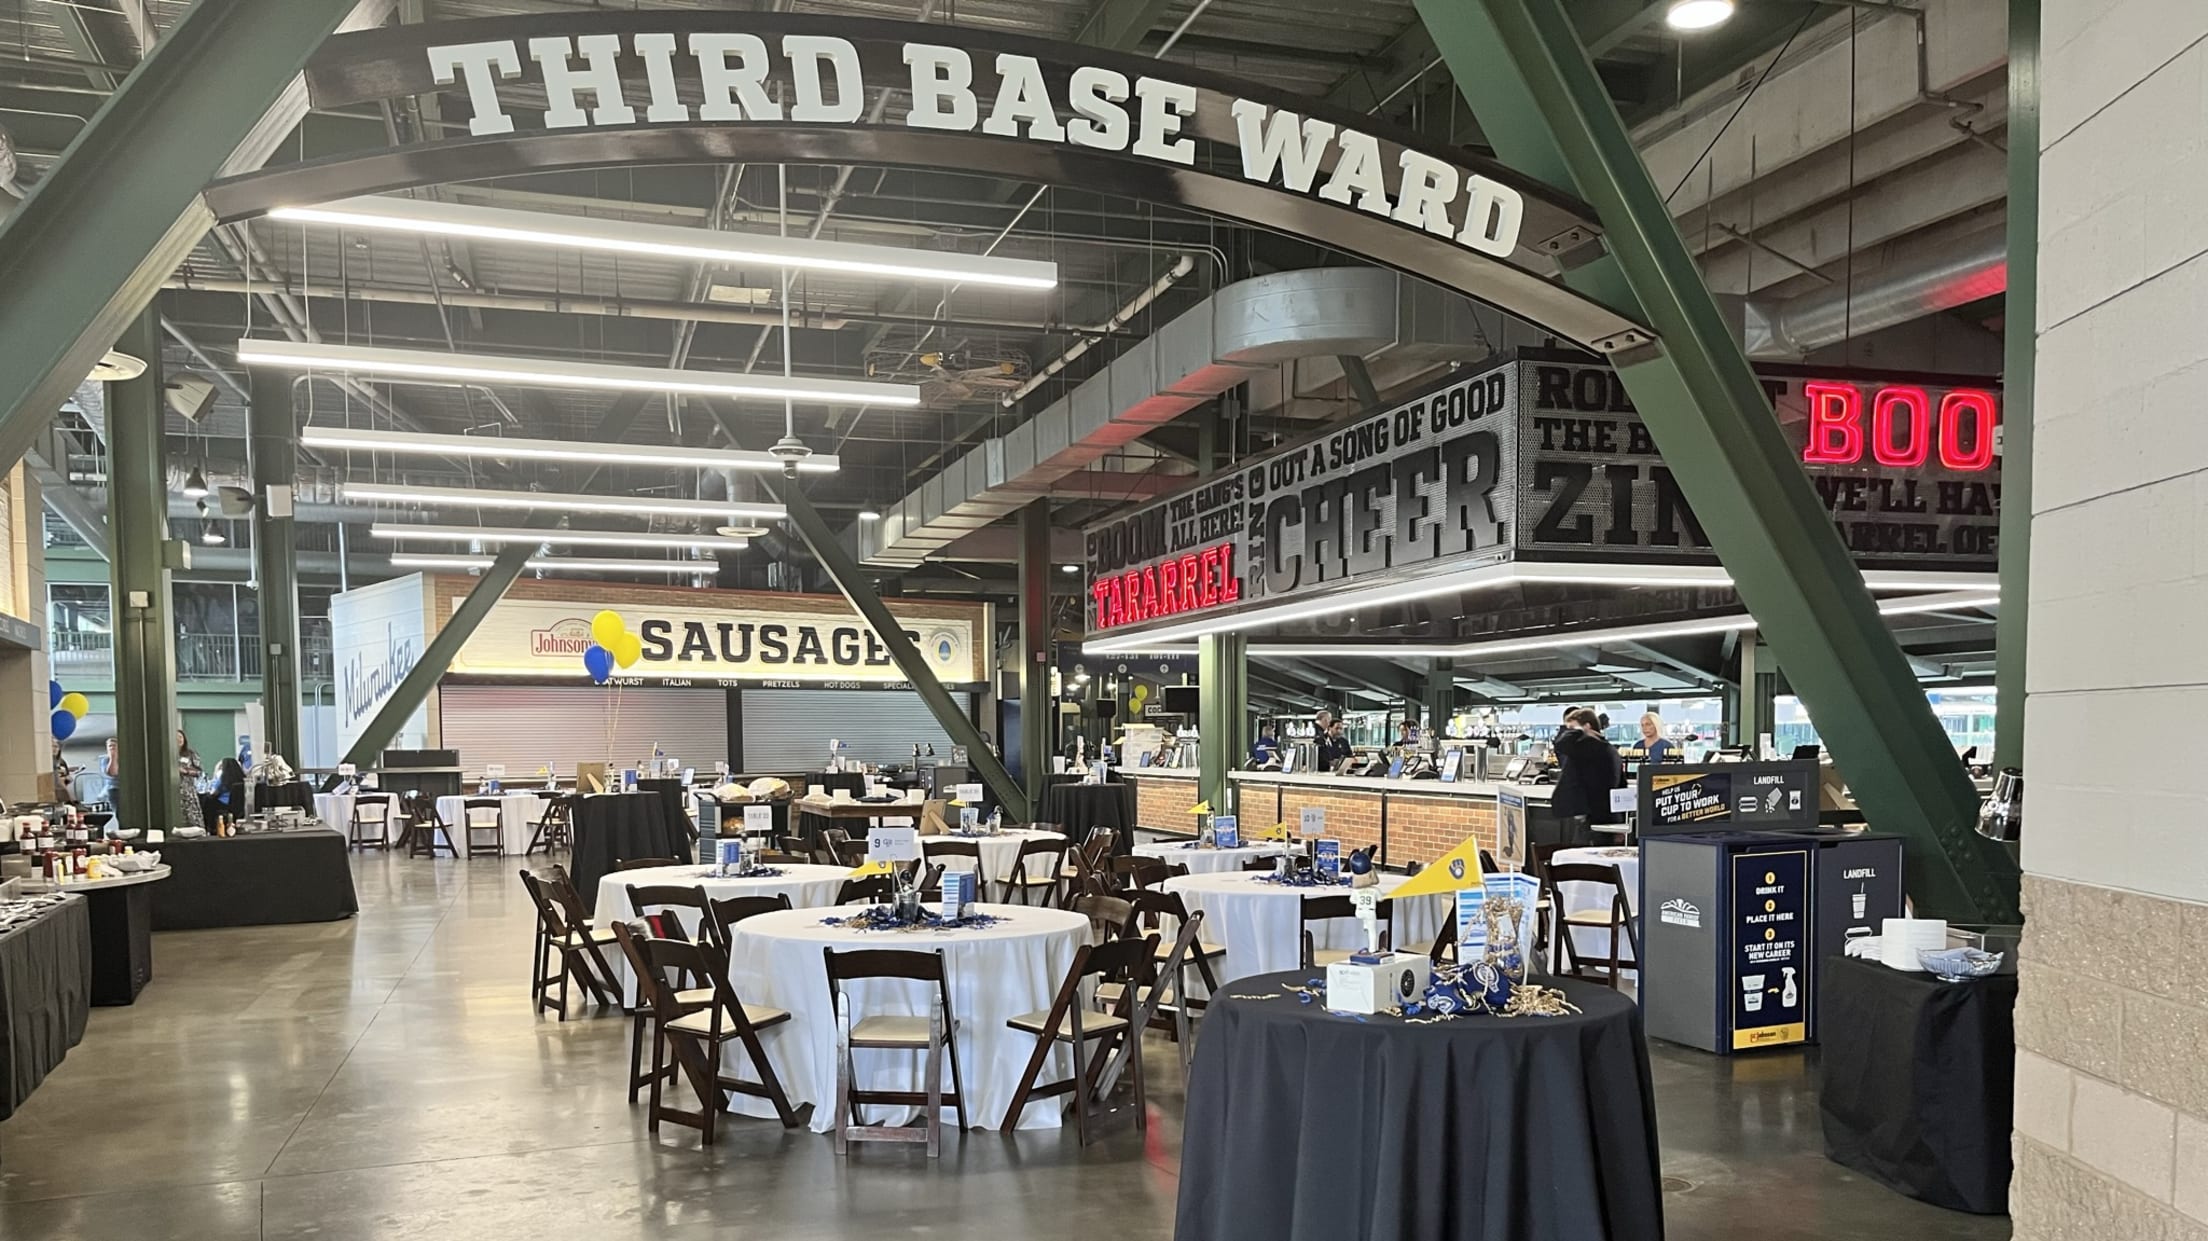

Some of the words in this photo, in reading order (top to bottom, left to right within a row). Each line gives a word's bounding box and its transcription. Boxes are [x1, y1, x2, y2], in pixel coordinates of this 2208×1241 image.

[427, 33, 866, 137] THIRD
[903, 43, 1197, 166] BASE
[1232, 97, 1525, 258] WARD
[1535, 366, 1639, 412] ROL
[1270, 452, 1309, 492] OUT
[1310, 442, 1327, 478] A
[1330, 417, 1389, 470] SONG
[1394, 403, 1425, 448] OF
[1431, 372, 1506, 433] GOOD
[1534, 417, 1618, 454] THE
[1803, 379, 1997, 472] BOO
[1169, 495, 1195, 523] THE
[1196, 474, 1244, 514] GANG'S
[1265, 430, 1505, 594] CHEER
[1533, 462, 1713, 548] ZIN
[1936, 480, 2001, 516] HA
[1097, 503, 1169, 574] BOOM
[1170, 520, 1198, 553] ALL
[1200, 501, 1245, 544] HERE!
[1094, 542, 1241, 630] TARARREL
[344, 621, 415, 729] Milwaukee
[594, 677, 645, 686] ATWURST
[662, 679, 692, 687] ITALIAN
[718, 679, 738, 687] TOTS
[762, 680, 800, 688] PRETZELS
[824, 680, 839, 689] HOT
[840, 681, 861, 689] DOGS
[1753, 775, 1785, 785] LANDFILL
[1655, 795, 1673, 808] PUT
[1674, 789, 1698, 803] YOUR
[1661, 804, 1679, 817] CUP
[1680, 801, 1692, 812] TO
[1693, 794, 1720, 809] WORK
[1681, 809, 1703, 820] BETTER
[1704, 803, 1726, 814] WORLD
[874, 838, 881, 848] 9
[1755, 886, 1777, 895] DRINK
[1777, 885, 1785, 894] IT
[1843, 868, 1876, 879] LANDFILL
[1359, 895, 1372, 906] 39
[1746, 914, 1768, 924] PLACE
[1768, 913, 1775, 922] IT
[1776, 911, 1794, 921] HERE
[1744, 943, 1765, 953] START
[1766, 942, 1773, 950] IT
[1774, 941, 1784, 950] ON
[1784, 940, 1795, 949] ITS
[1748, 951, 1764, 960] NEW
[1765, 949, 1791, 959] CAREER
